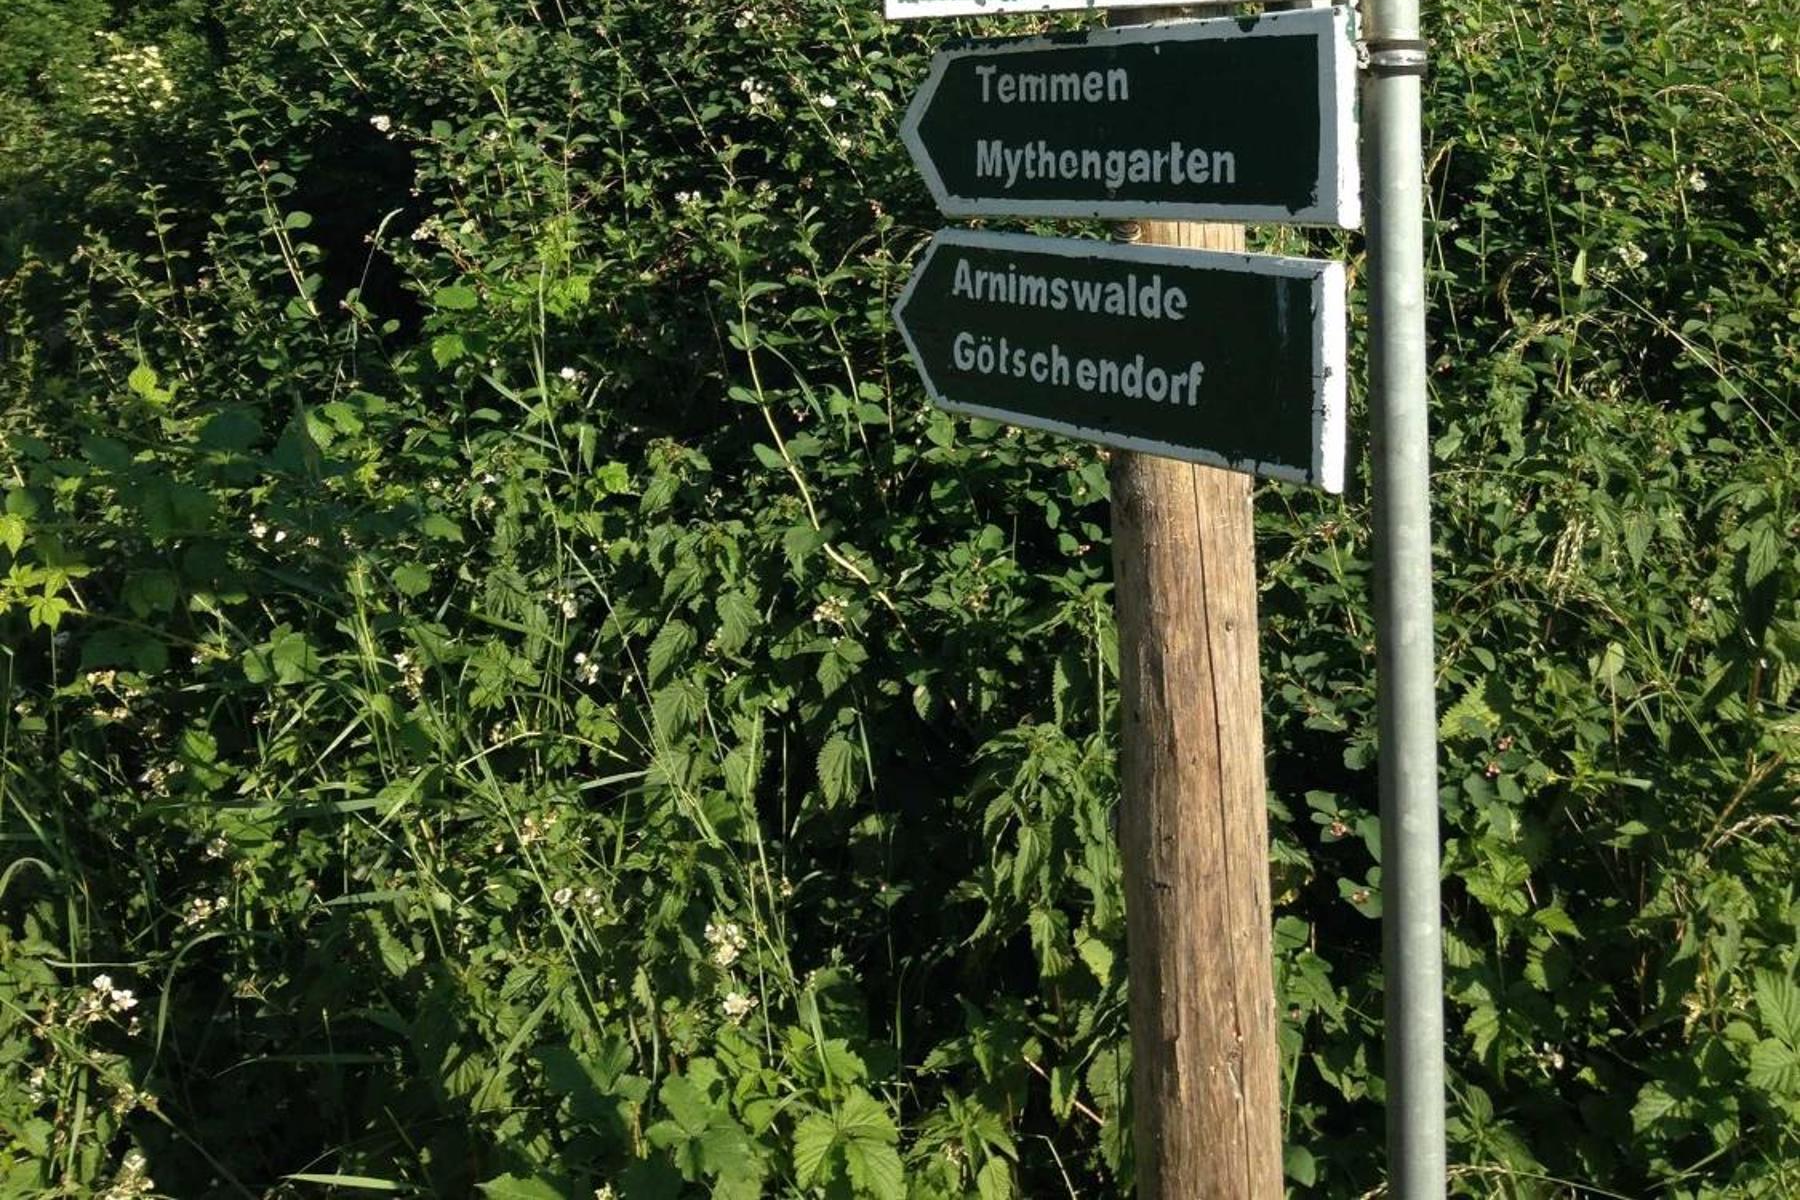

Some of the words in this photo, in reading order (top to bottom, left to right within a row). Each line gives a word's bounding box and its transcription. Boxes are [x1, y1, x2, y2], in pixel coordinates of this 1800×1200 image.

[975, 64, 1129, 104] Temmen
[952, 258, 1188, 321] Arnimswalde
[953, 331, 1205, 407] Götschendorf
